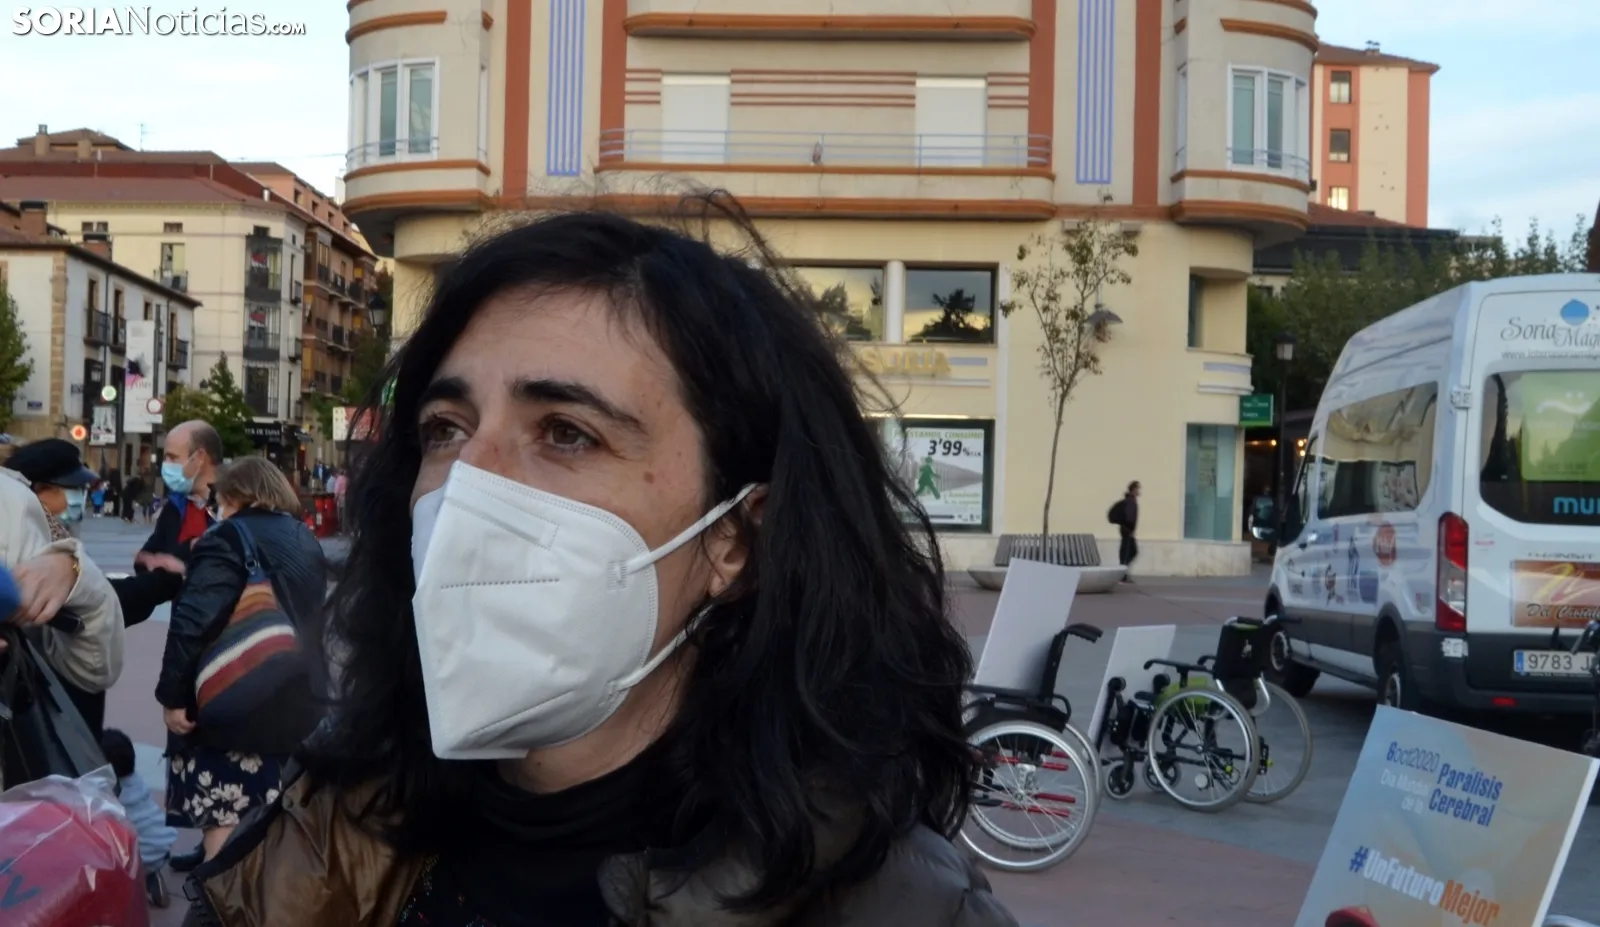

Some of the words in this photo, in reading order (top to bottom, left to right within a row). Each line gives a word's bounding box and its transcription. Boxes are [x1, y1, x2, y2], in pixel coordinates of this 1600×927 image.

[1500, 316, 1557, 341] Soria
[927, 438, 963, 456] 3'99
[1527, 654, 1573, 671] 9783
[1437, 762, 1503, 801] Parálisis
[1428, 788, 1496, 827] Cerebral
